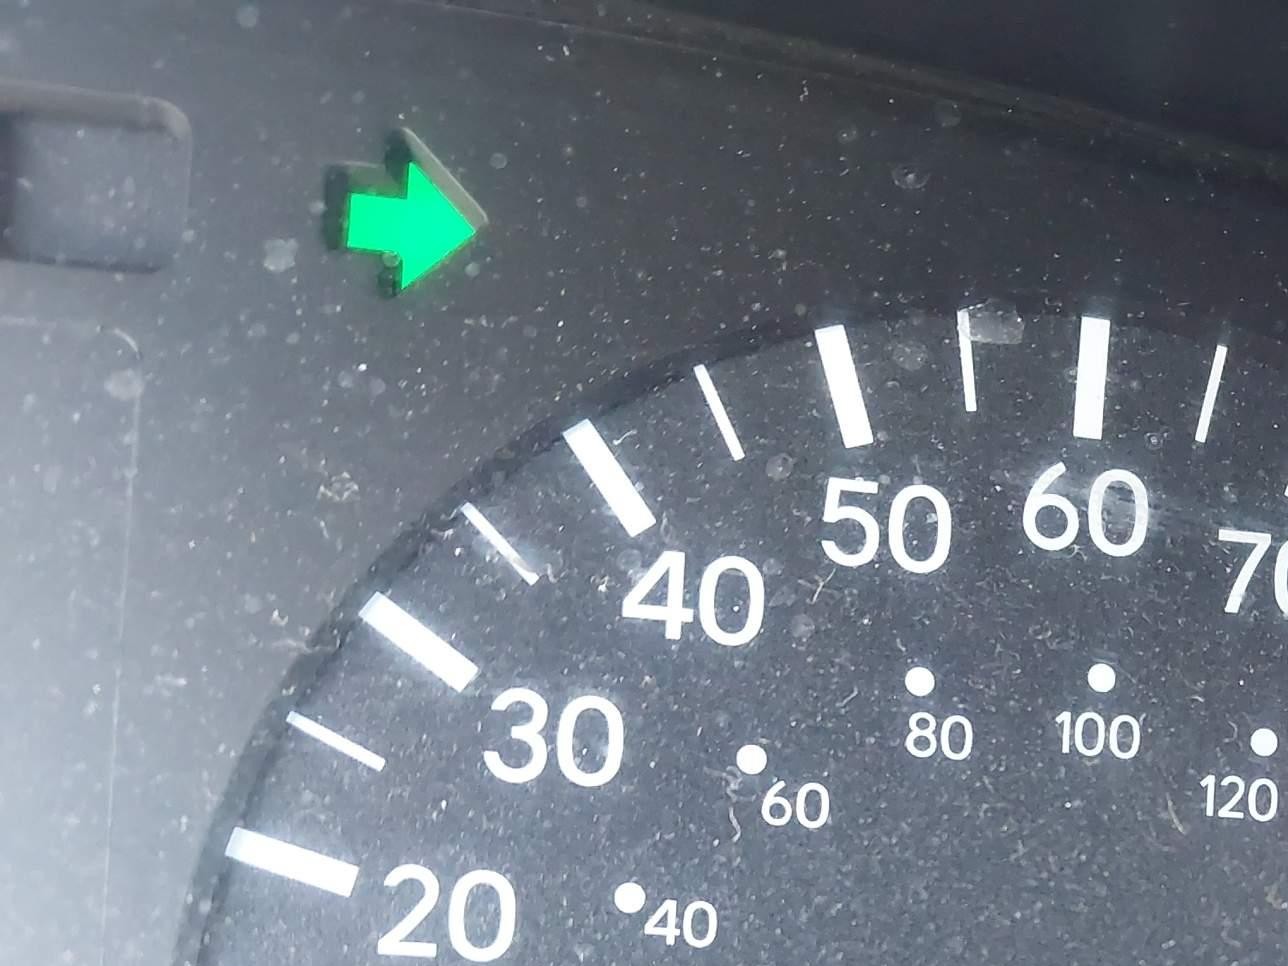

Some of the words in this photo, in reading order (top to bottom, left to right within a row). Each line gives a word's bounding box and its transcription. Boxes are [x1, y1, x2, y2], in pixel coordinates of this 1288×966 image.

[822, 477, 951, 573] 50
[1023, 462, 1150, 556] 60
[622, 551, 764, 646] 40
[484, 688, 623, 786] 30
[905, 712, 973, 760] 80
[1056, 712, 1140, 759] 100
[762, 781, 829, 828] 60
[1200, 775, 1278, 821] 120
[378, 864, 515, 962] 20
[644, 900, 717, 948] 40
